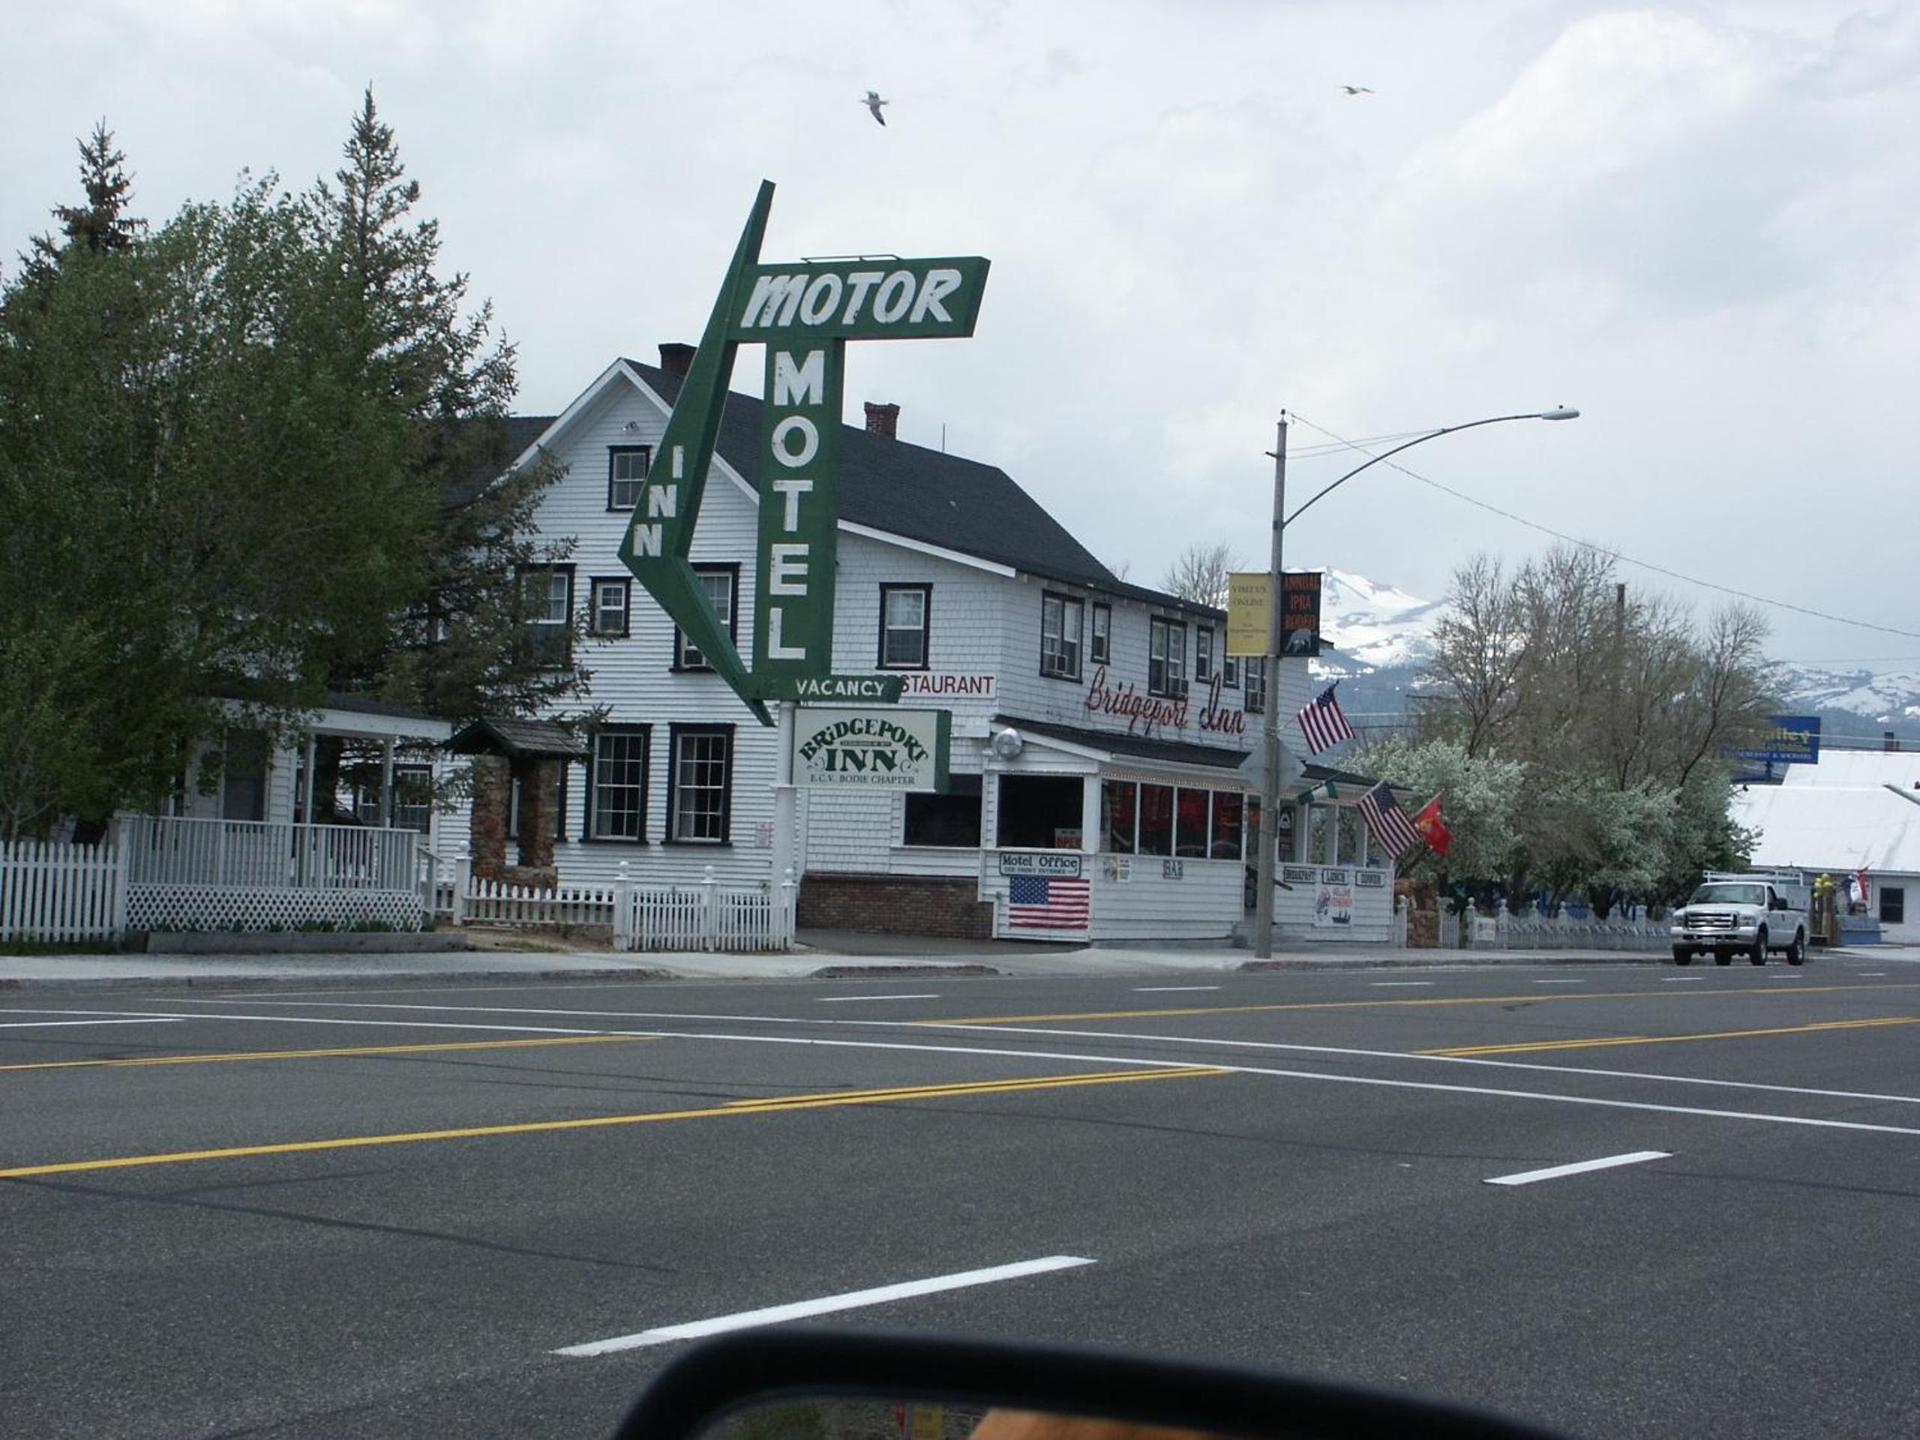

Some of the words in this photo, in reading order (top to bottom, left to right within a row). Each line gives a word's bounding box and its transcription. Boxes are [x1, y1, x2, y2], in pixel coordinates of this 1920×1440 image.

[740, 269, 962, 328] MOTOR
[633, 445, 685, 557] INN
[768, 350, 825, 660] MOTEL
[795, 679, 887, 697] VACANCY
[901, 675, 994, 694] STAURANT
[1087, 666, 1188, 735] Bridgeport
[1200, 672, 1246, 735] Inn
[825, 748, 899, 773] INN
[839, 775, 869, 785] BODIE
[871, 775, 915, 786] CHAPTER
[1003, 855, 1033, 867] Motel
[1039, 856, 1078, 868] Office
